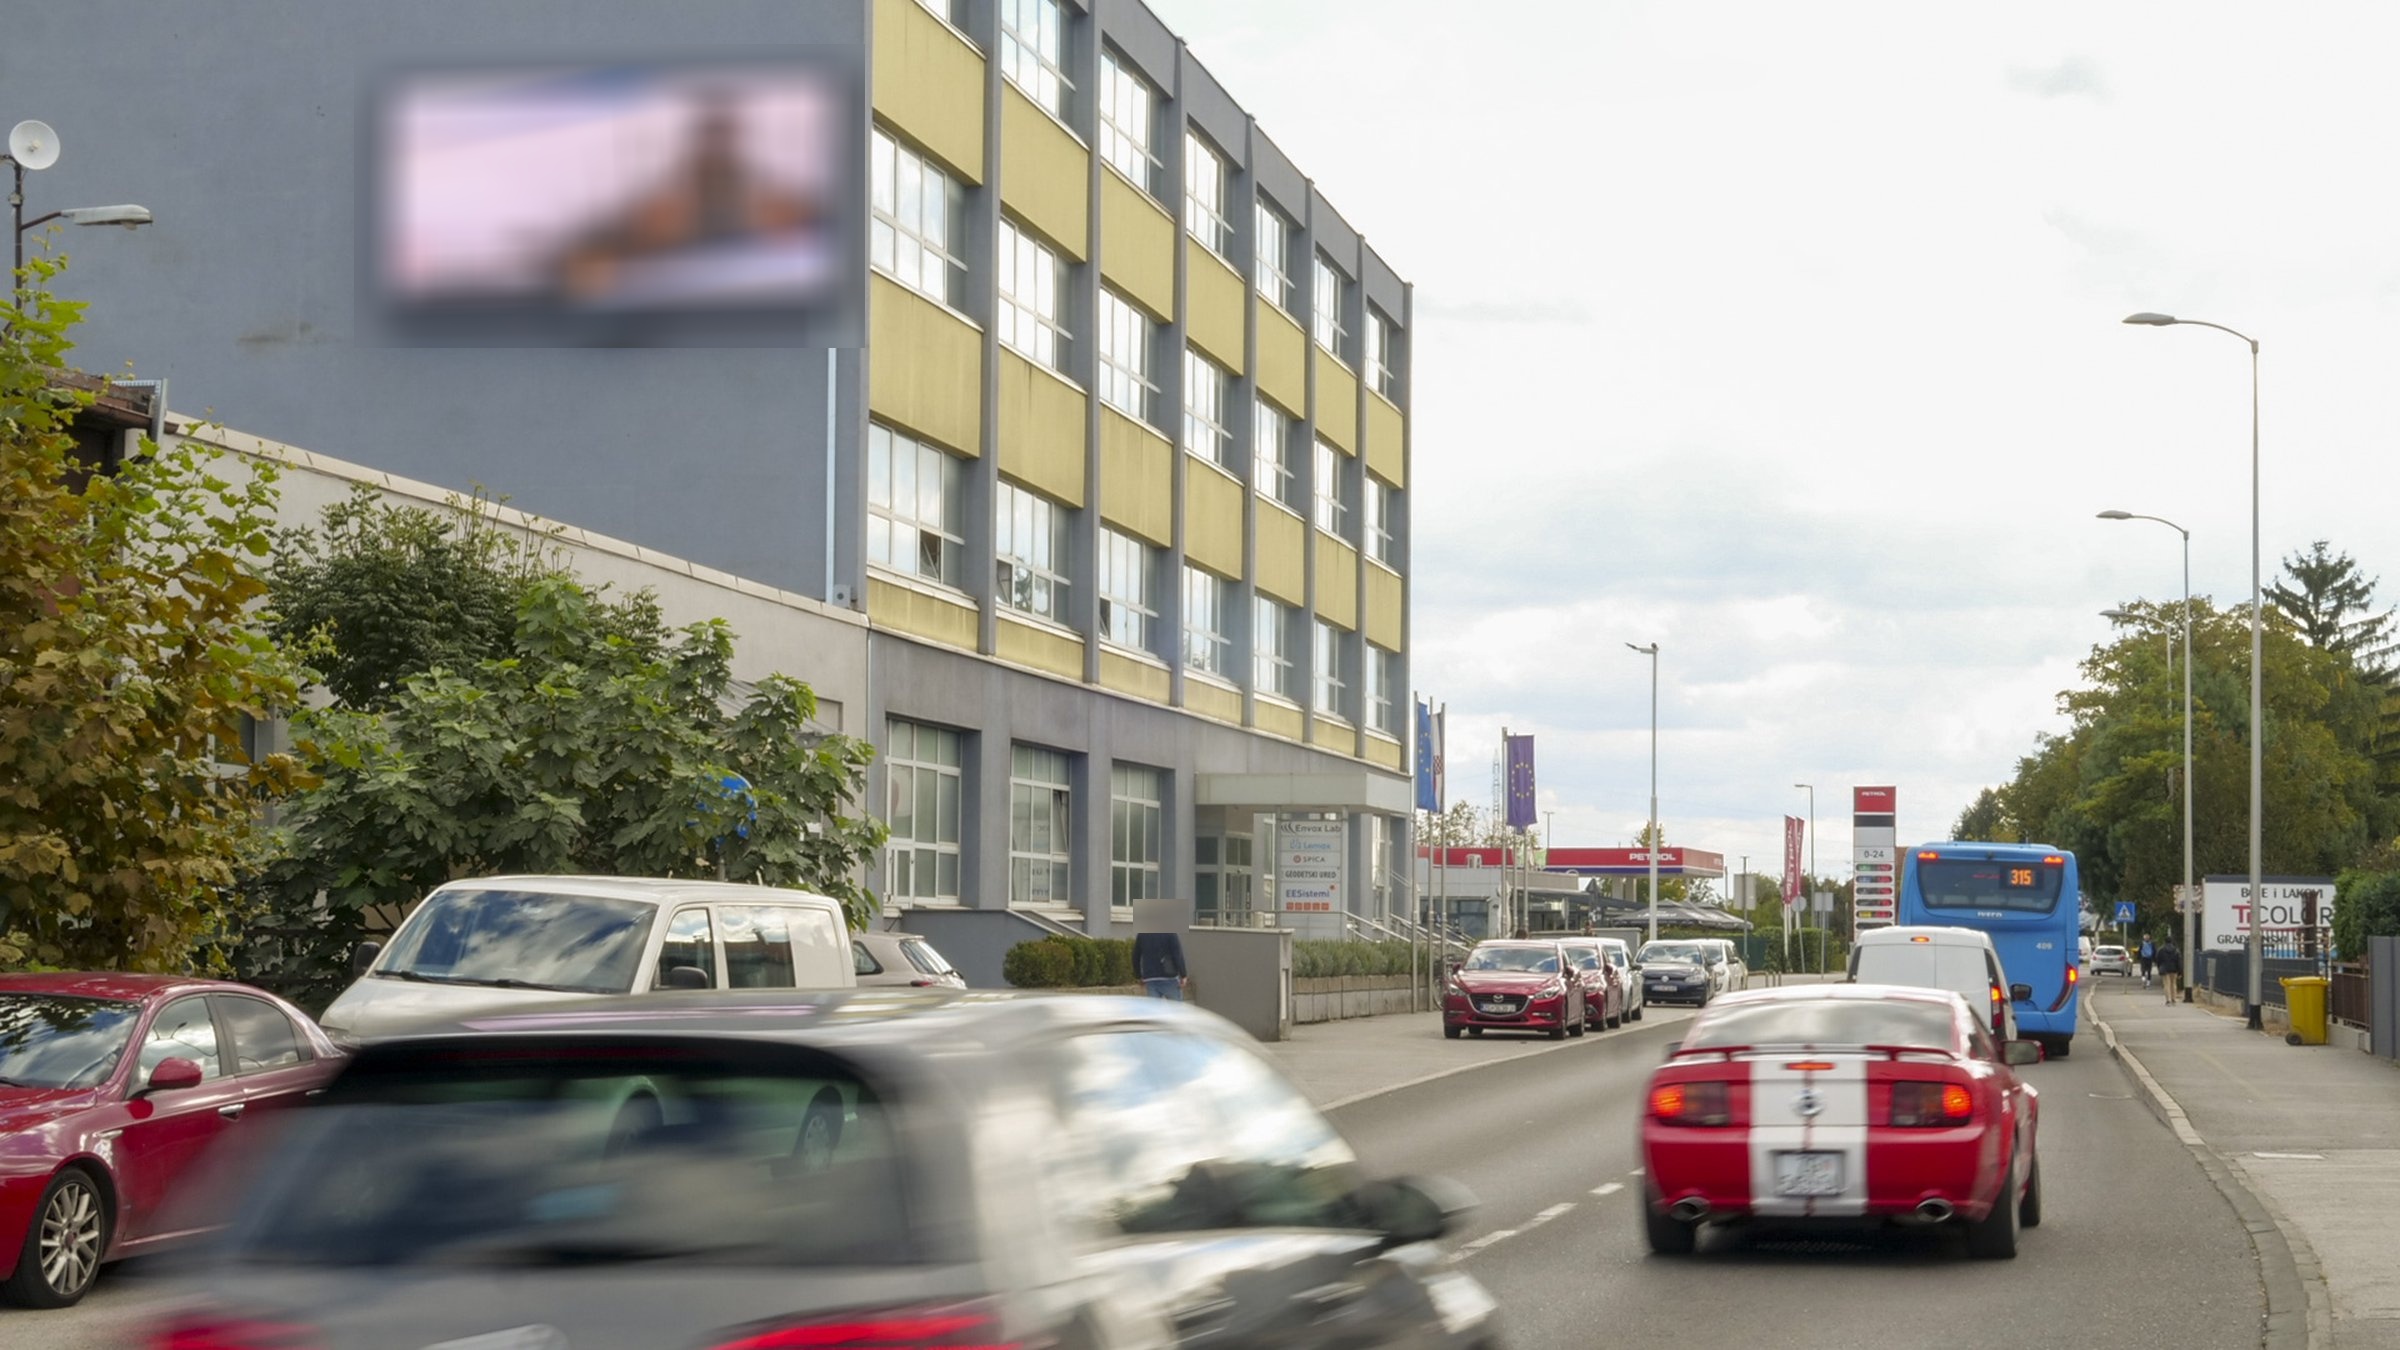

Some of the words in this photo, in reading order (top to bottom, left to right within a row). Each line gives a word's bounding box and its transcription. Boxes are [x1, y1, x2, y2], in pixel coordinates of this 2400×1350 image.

[1295, 824, 1322, 832] Envox
[1324, 824, 1342, 832] Lab
[1864, 850, 1885, 859] 0-24
[1285, 870, 1318, 878] GEODETSKI
[1319, 870, 1337, 878] URED
[2010, 869, 2032, 886] 315
[2241, 888, 2268, 898] BE
